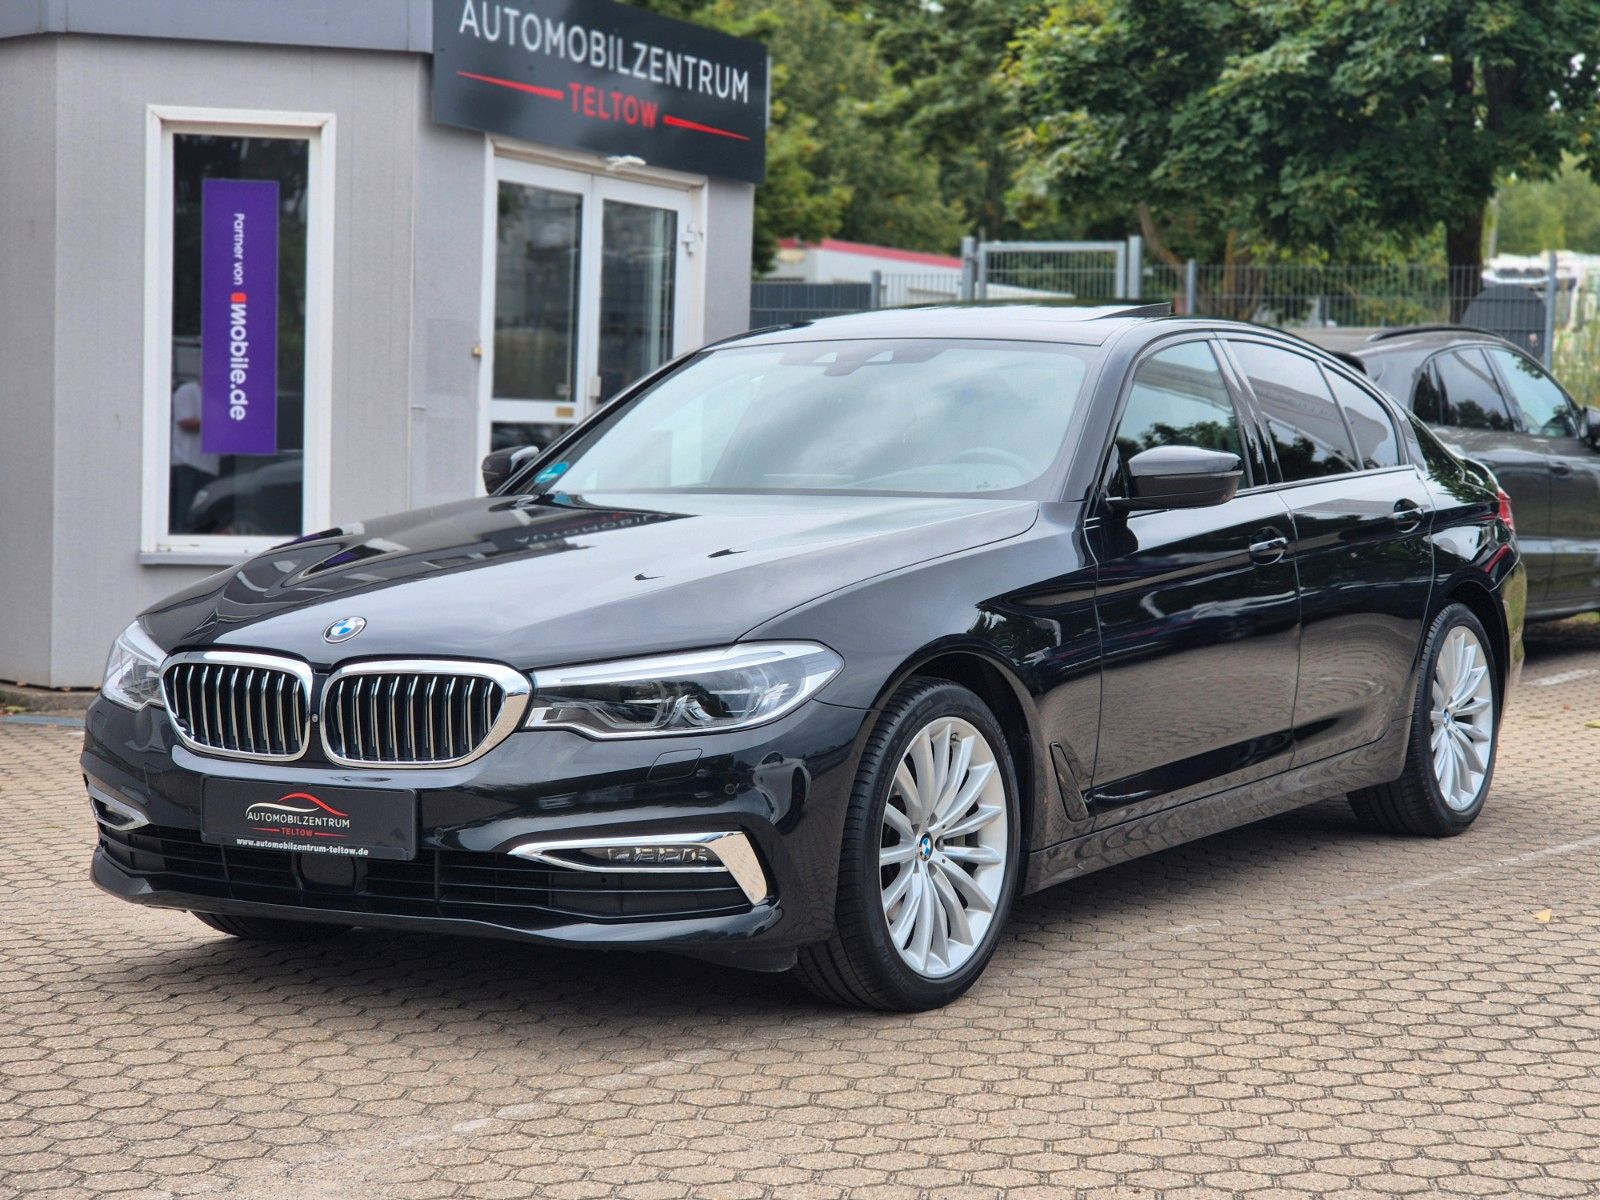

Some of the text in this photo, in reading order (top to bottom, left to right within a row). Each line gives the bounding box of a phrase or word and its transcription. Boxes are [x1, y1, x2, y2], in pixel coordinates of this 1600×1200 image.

[459, 0, 749, 104] AUTOMOBILZENTRUM
[568, 83, 659, 128] TELTOW
[229, 213, 249, 421] Partner von mobile.de
[247, 811, 350, 828] AUTOMOBILZENTRUM
[281, 827, 313, 837] TELTOW
[236, 838, 369, 856] www.automobilzentrum-teltow.de
